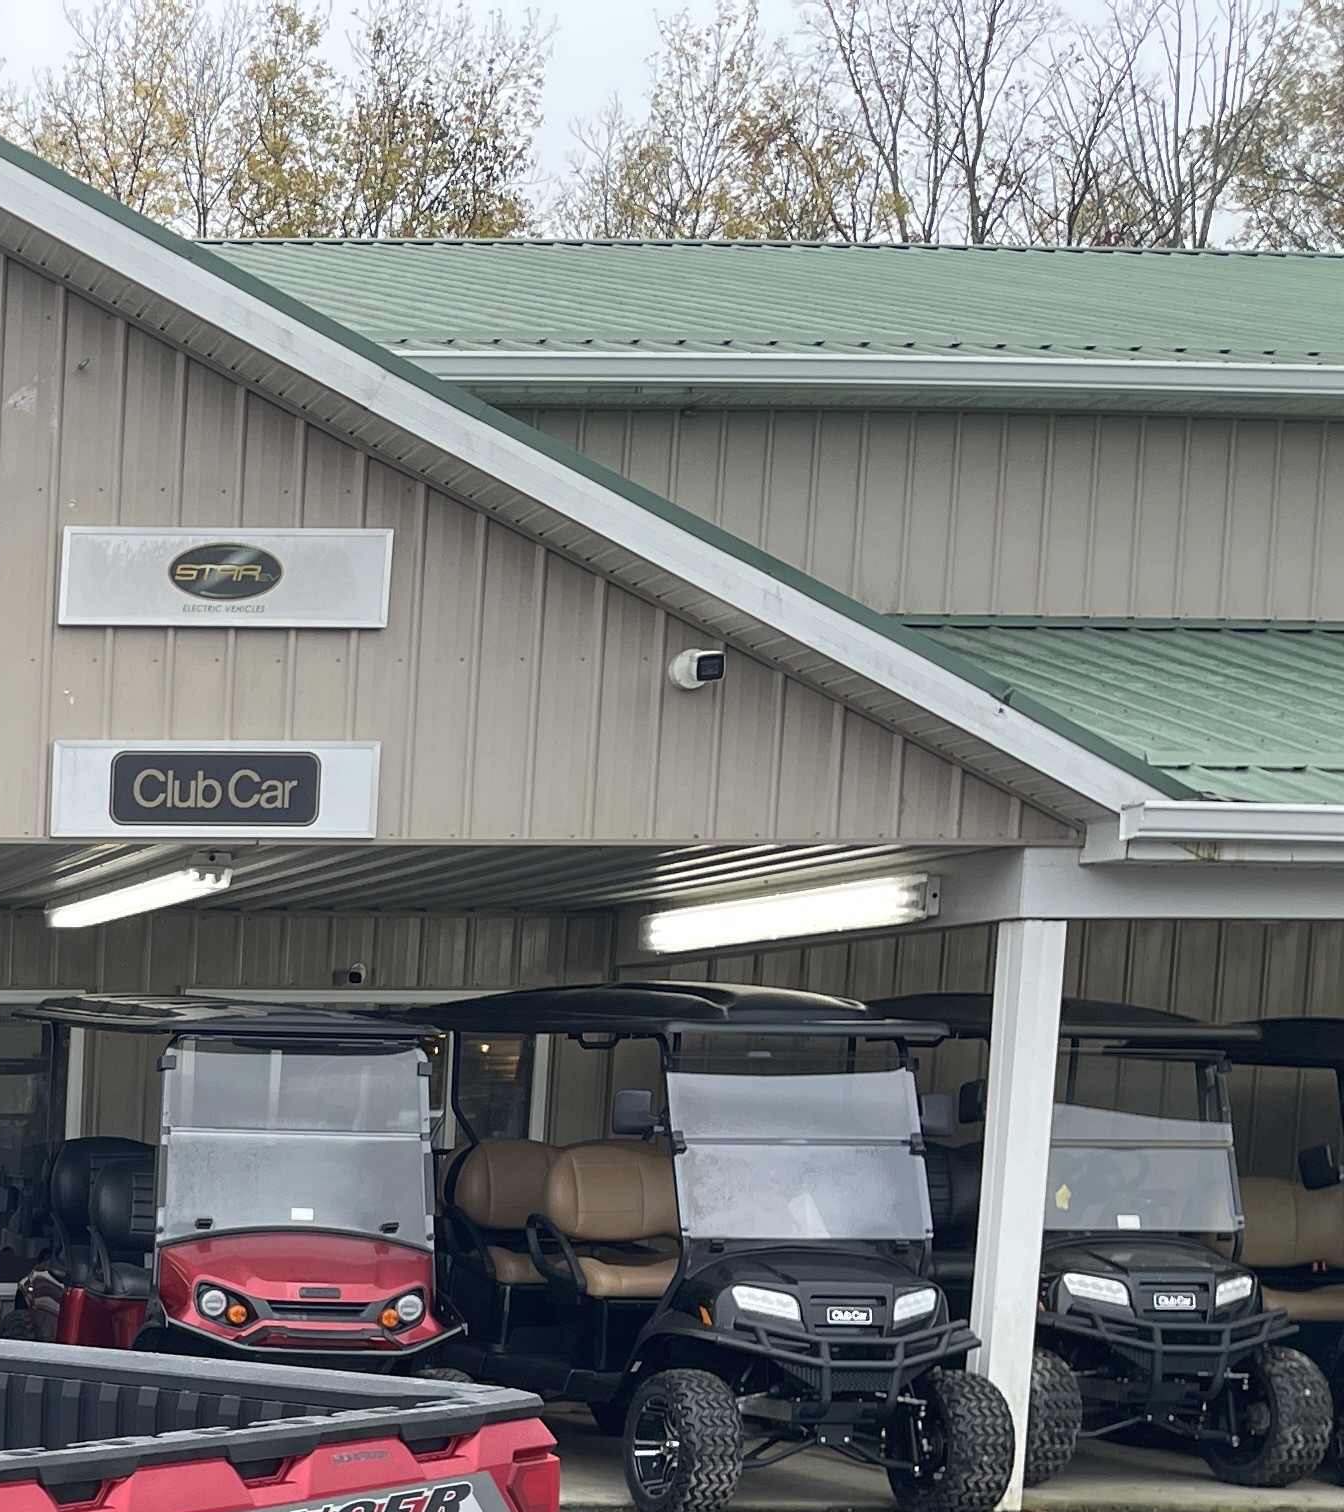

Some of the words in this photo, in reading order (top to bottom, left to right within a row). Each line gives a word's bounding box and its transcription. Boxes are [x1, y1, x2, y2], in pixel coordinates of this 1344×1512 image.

[174, 564, 263, 582] STAR
[182, 604, 222, 614] ELECTRIC
[225, 604, 265, 614] VEHICLES
[133, 769, 222, 809] Club
[227, 769, 298, 809] Car
